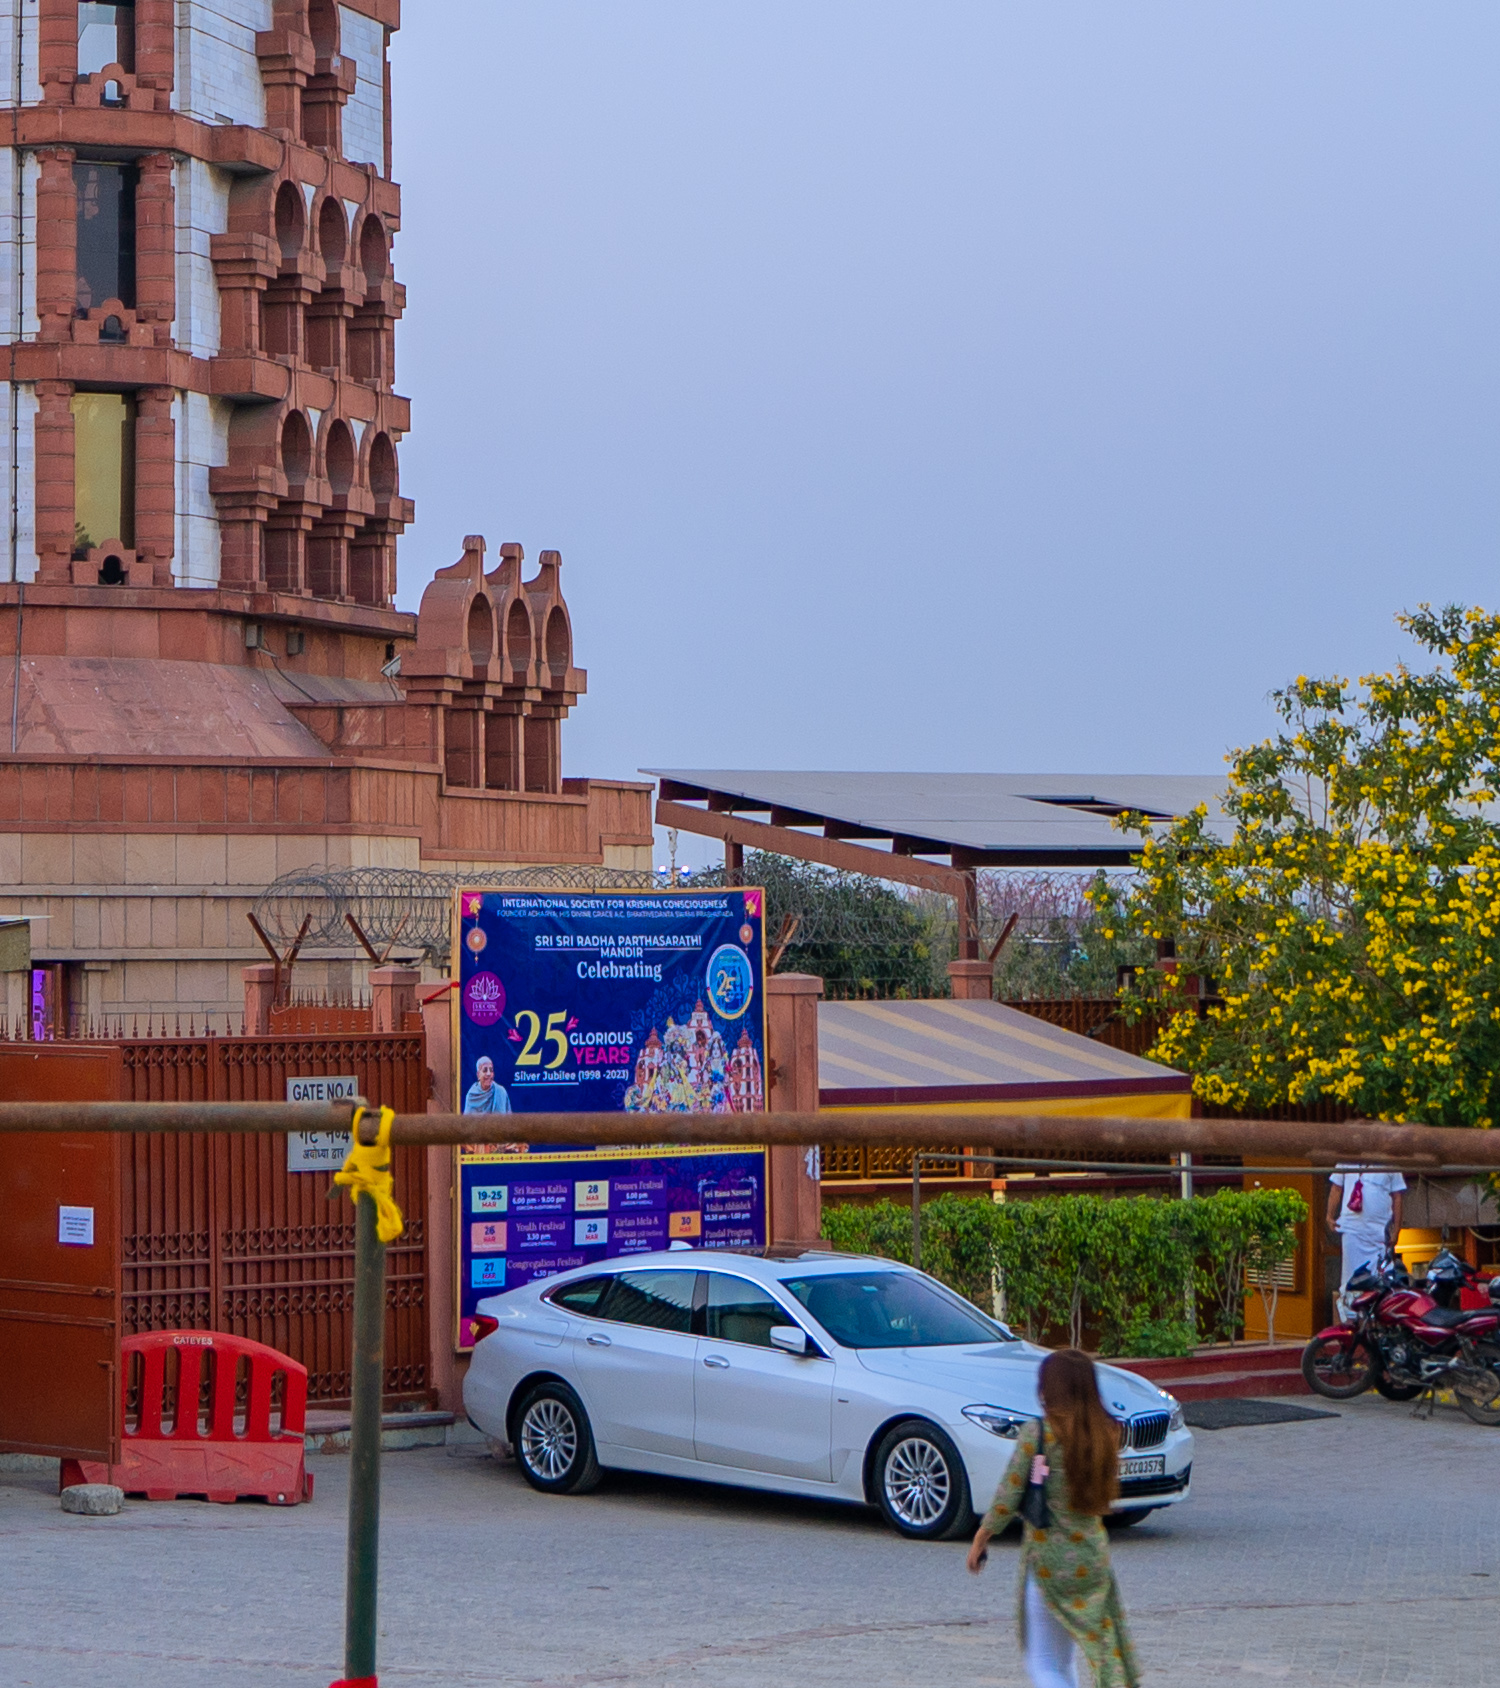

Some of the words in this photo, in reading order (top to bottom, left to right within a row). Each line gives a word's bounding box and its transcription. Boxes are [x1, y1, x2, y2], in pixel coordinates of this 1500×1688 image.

[502, 898, 569, 909] INTERNATIONAL
[570, 899, 605, 909] SOCIETY
[607, 899, 624, 909] FOR
[626, 899, 661, 909] KRISHNA
[662, 899, 728, 909] CONSCIOUSNESS
[535, 935, 553, 947] SRI
[556, 935, 574, 947] SRI
[577, 935, 615, 947] RADHA
[618, 935, 702, 947] PARTHASARATHI
[600, 947, 643, 958] MANDIR
[577, 961, 662, 982] Celebrating
[515, 1009, 568, 1069] 25
[570, 1031, 633, 1046] GLORIOUS
[573, 1047, 630, 1065] YEARS
[514, 1071, 541, 1081] Silver
[543, 1071, 576, 1081] Jubilee
[293, 1084, 323, 1100] GATE
[347, 1083, 353, 1096] 4
[514, 1186, 524, 1195] Sri
[588, 1185, 598, 1193] 28
[478, 1191, 502, 1200] 19-25
[681, 1216, 691, 1225] 30
[516, 1222, 536, 1231] Youth
[539, 1221, 566, 1230] Festival
[587, 1223, 597, 1232] 29
[484, 1263, 494, 1272] 27
[507, 1259, 555, 1269] Congregation
[557, 1257, 583, 1266] Festival
[174, 1336, 213, 1345] CATEYES
